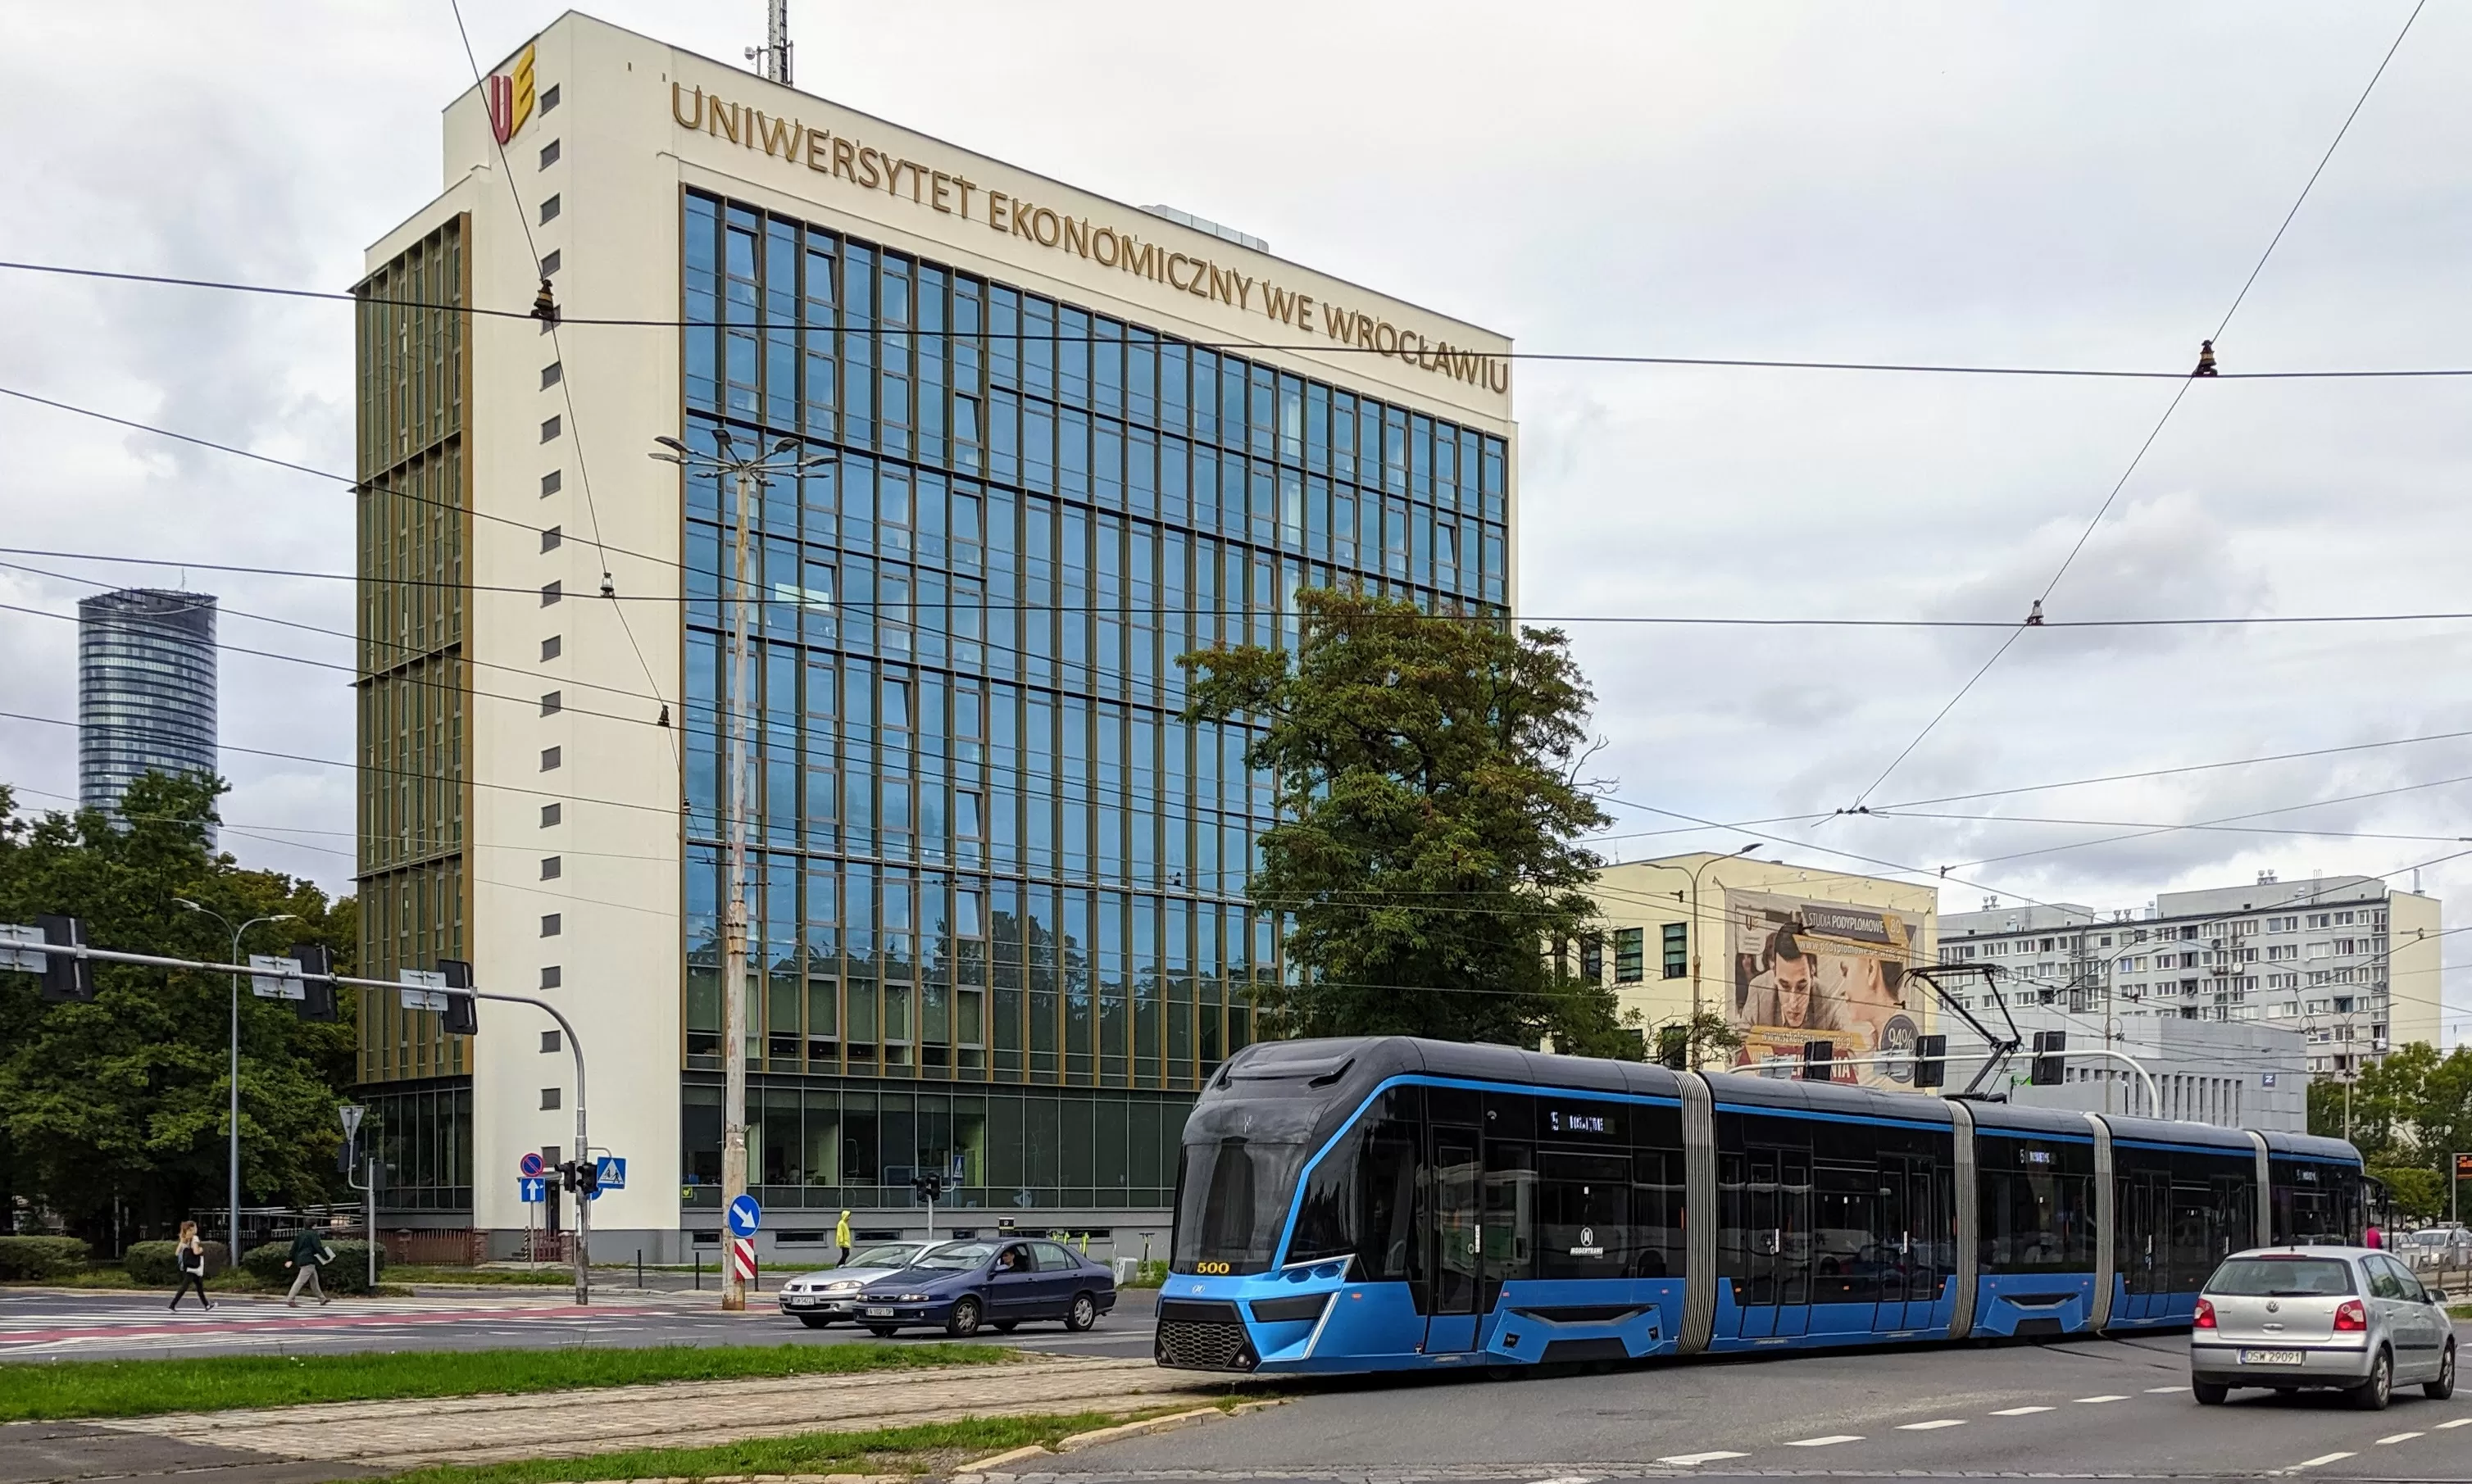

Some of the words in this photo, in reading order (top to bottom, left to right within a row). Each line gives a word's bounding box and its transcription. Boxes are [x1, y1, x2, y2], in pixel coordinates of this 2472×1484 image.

[672, 82, 976, 219] UNIWERSYTET
[988, 190, 1253, 308] EKONOMICZNY
[1263, 281, 1314, 332] WE
[1323, 302, 1508, 393] WROCŁAWIU
[1808, 912, 1832, 928] STUDIA
[1832, 915, 1884, 933] PODYPLOMOWE
[1888, 1028, 1914, 1052] 94%
[1197, 1262, 1230, 1274] 500
[2247, 1351, 2265, 1361] DSW
[2269, 1352, 2300, 1362] 29091
